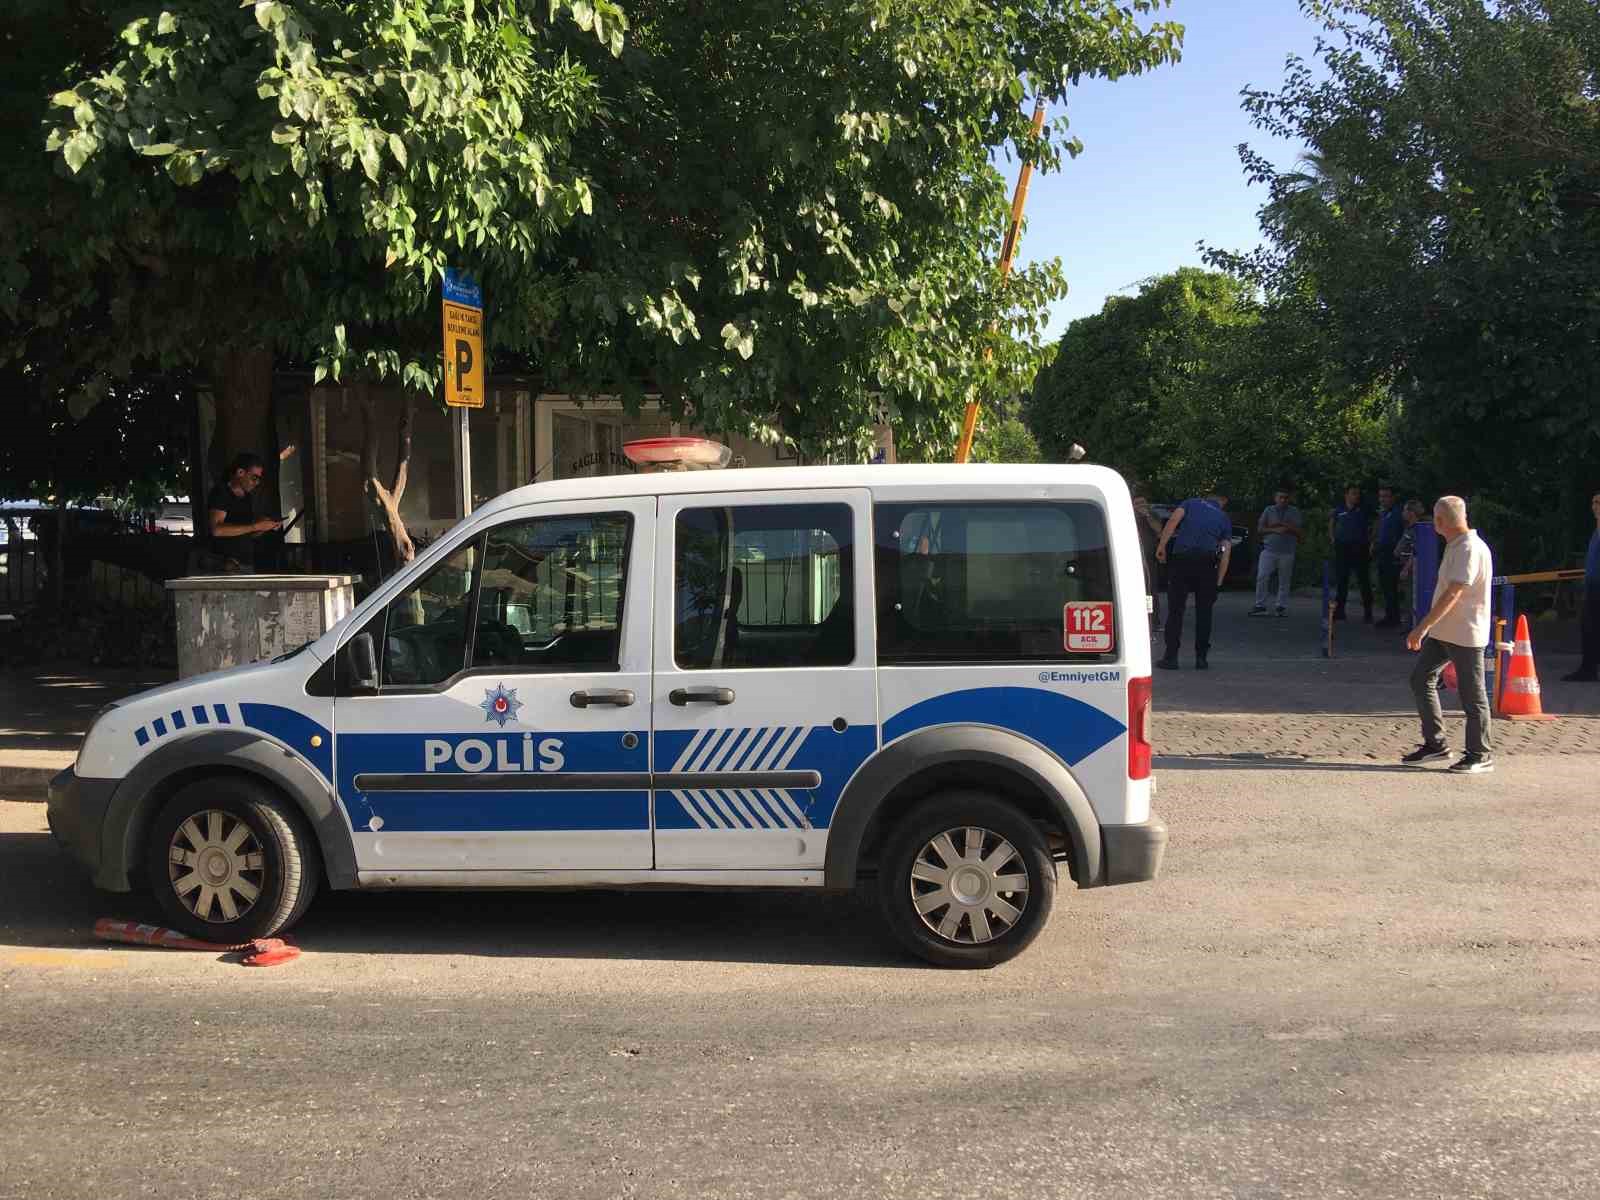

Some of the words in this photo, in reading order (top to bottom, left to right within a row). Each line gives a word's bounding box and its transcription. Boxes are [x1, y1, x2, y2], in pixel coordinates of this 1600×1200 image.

[455, 338, 473, 393] P
[1073, 608, 1106, 631] 112
[1038, 671, 1120, 683] @EmniyetGM
[424, 732, 565, 773] POLİS
